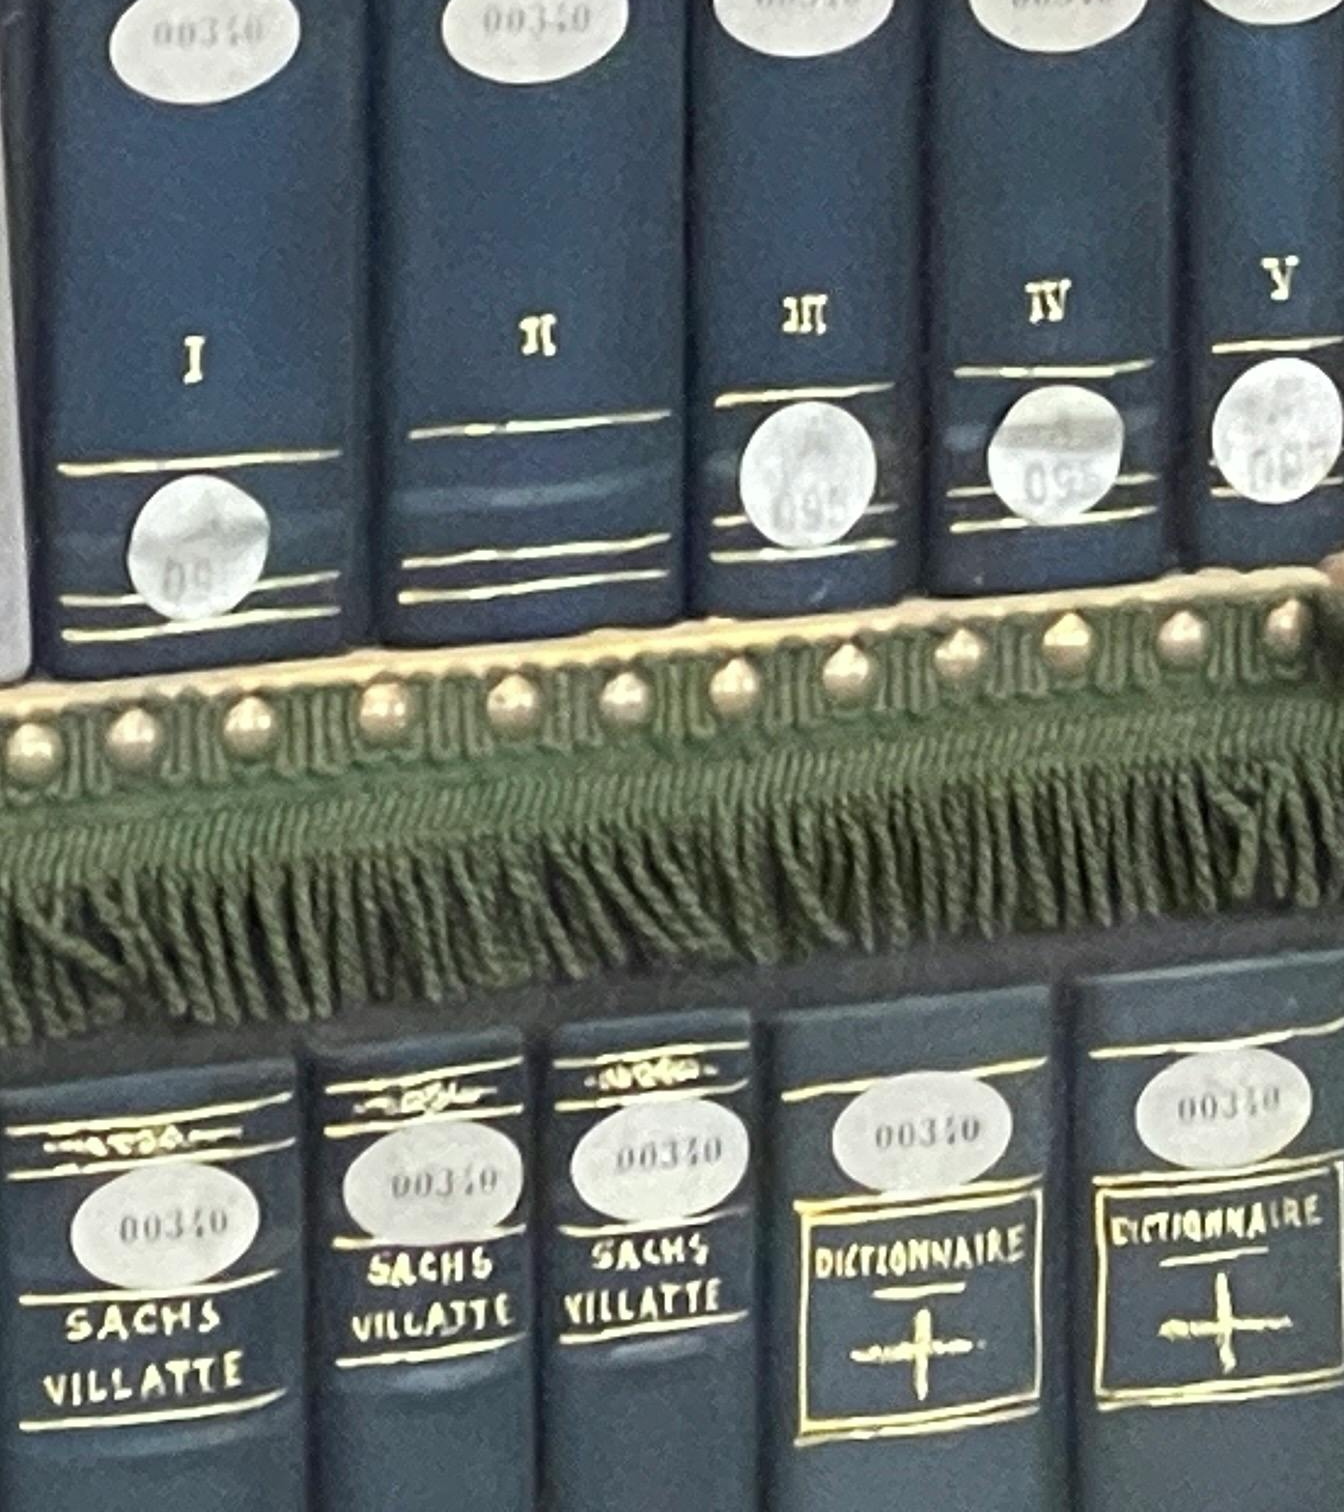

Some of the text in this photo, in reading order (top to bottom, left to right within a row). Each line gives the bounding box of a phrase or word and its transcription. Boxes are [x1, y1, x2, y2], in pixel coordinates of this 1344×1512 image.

[1023, 278, 1072, 325] IV
[183, 334, 206, 385] I
[1110, 1192, 1325, 1249] DICTIONNAIRE
[367, 1245, 494, 1288] SACHS
[590, 1231, 711, 1272] SACHS
[813, 1223, 1026, 1280] DICTIONNAIRE
[64, 1298, 222, 1344] SACHS
[351, 1292, 514, 1344] VILLATTE
[563, 1277, 723, 1325] VILLATTE
[42, 1349, 245, 1408] VILLATTE
